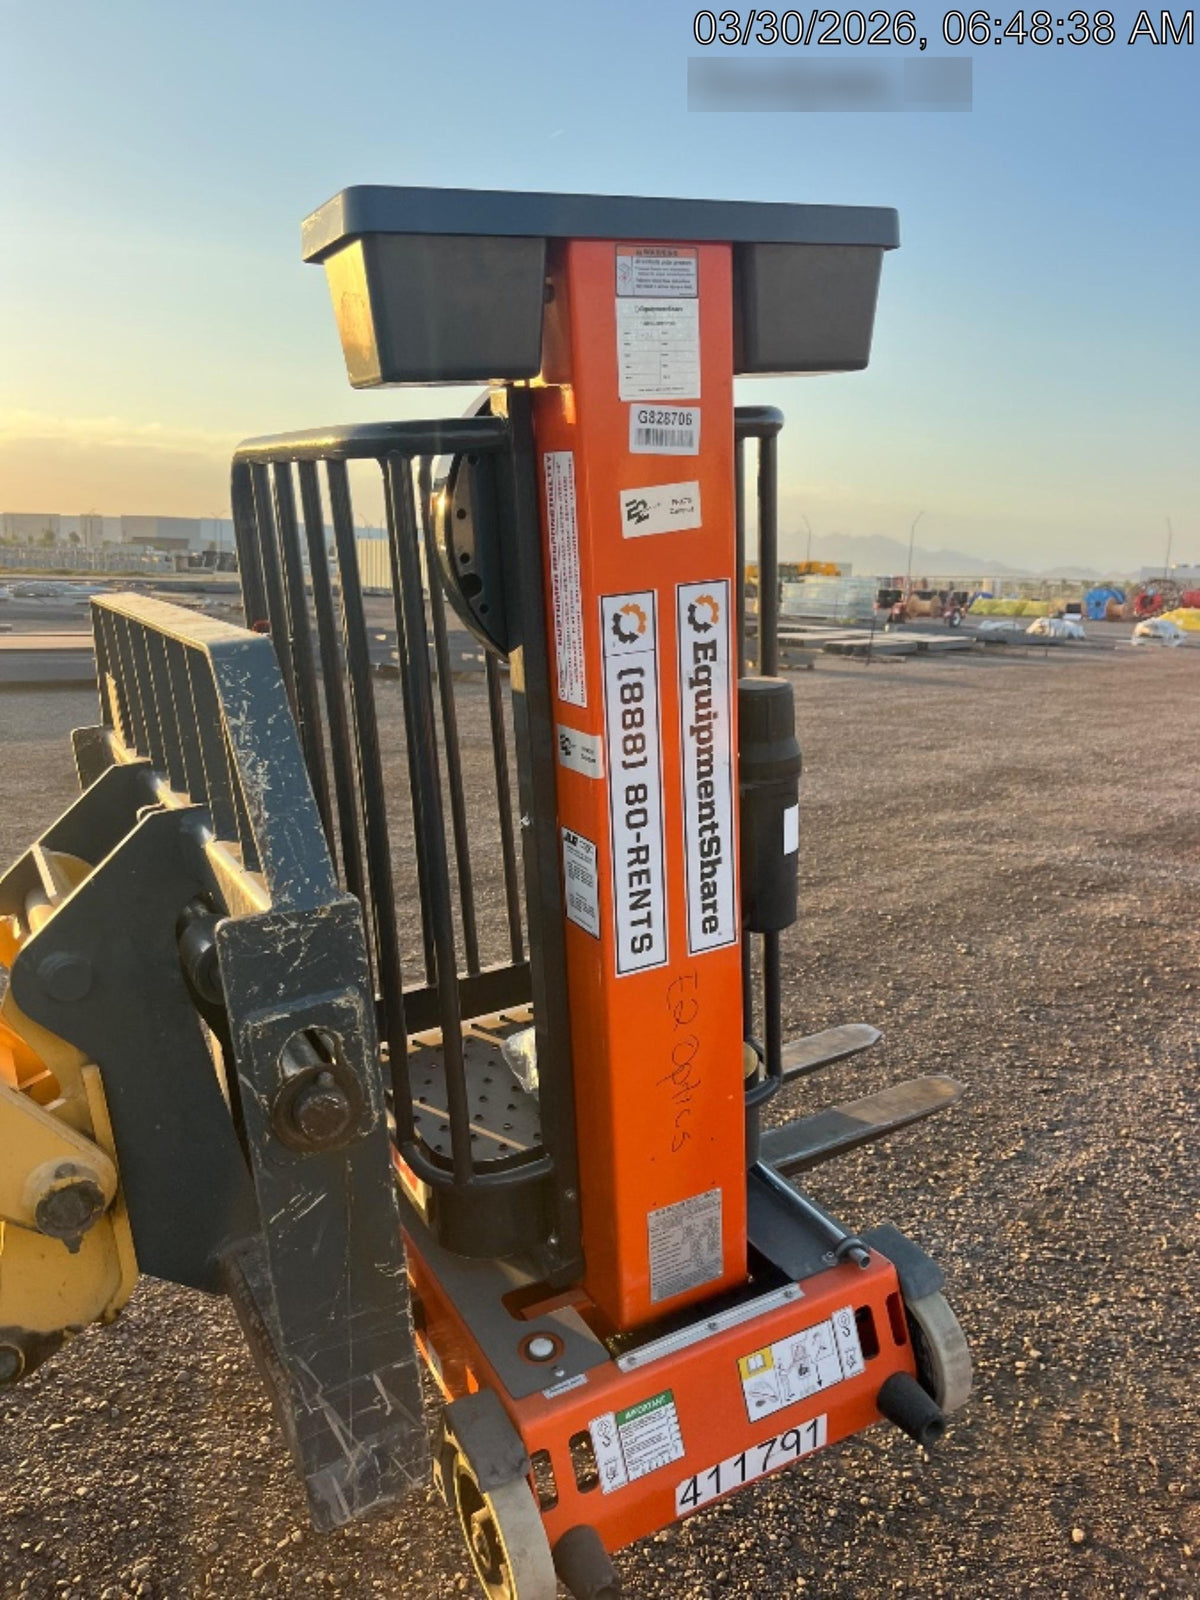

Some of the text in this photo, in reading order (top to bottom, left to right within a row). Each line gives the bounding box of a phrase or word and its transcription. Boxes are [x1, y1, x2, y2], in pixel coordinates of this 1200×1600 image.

[637, 410, 693, 426] G828706
[688, 638, 723, 934] EquipmentShare
[625, 783, 654, 954] 80-RENTS
[679, 1417, 820, 1507] 411791
